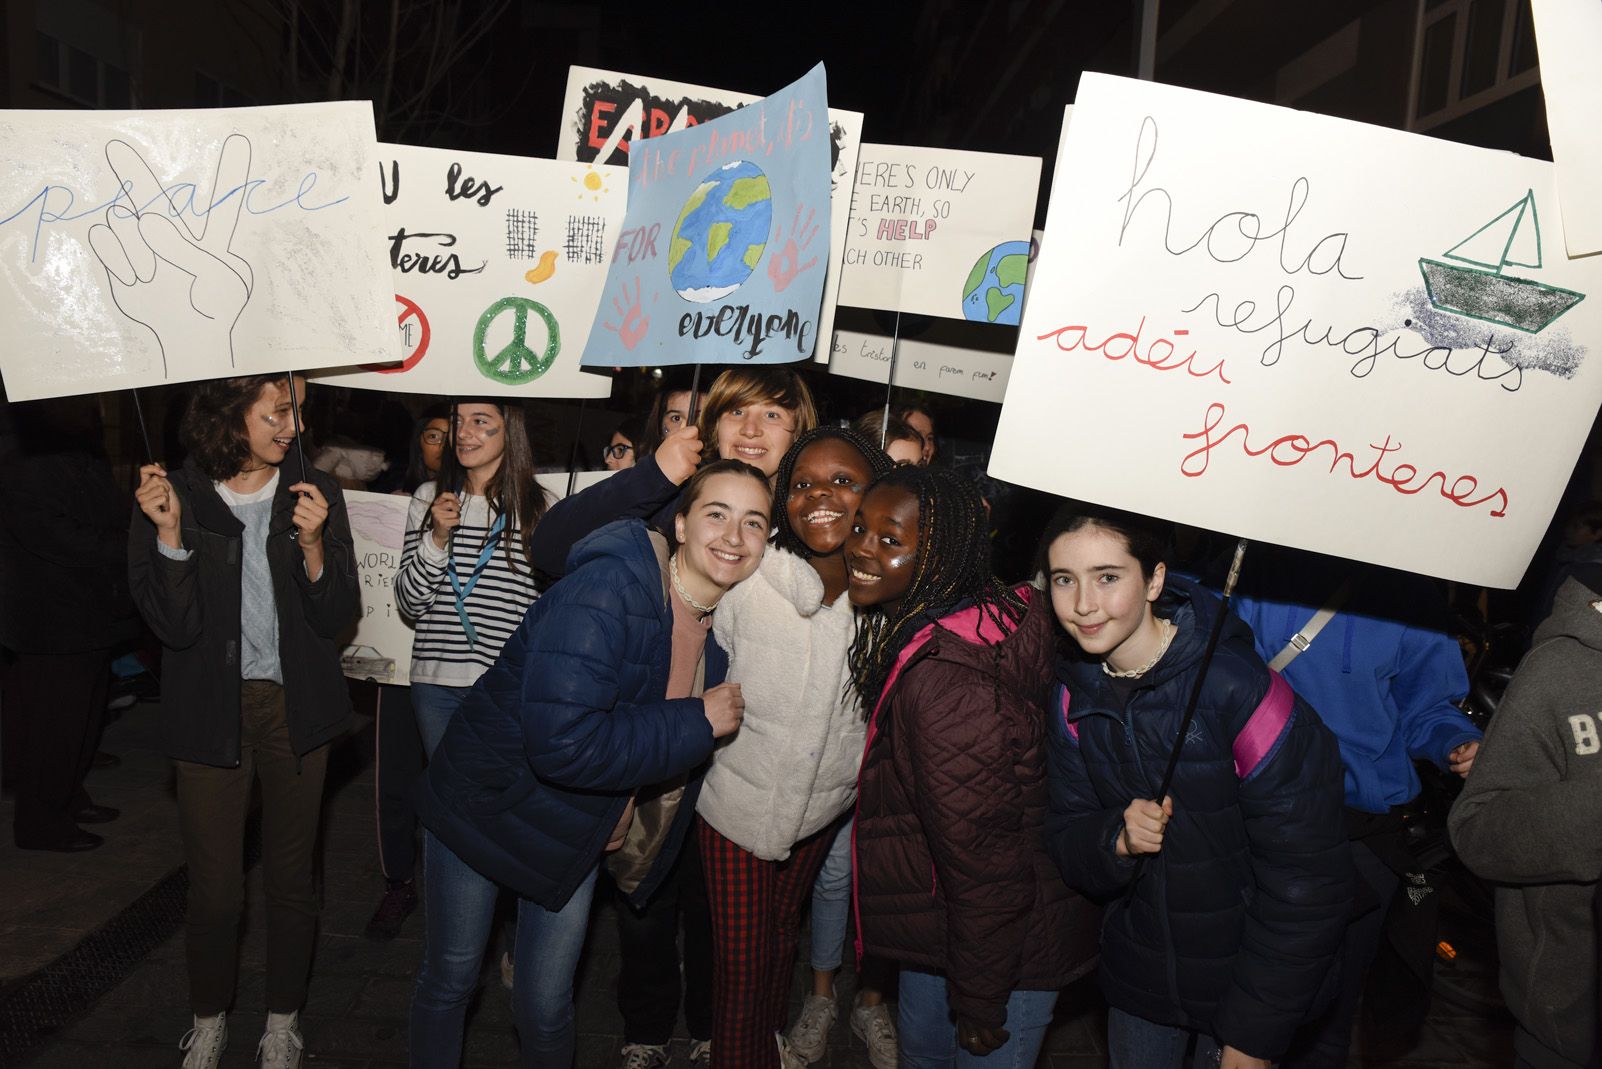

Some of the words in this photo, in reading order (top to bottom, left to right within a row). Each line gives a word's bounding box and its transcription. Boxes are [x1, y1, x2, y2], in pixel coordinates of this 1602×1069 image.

[445, 162, 504, 207] les
[855, 161, 917, 189] ERE'S
[925, 165, 976, 193] ONLY
[1117, 115, 1365, 281] hola
[0, 172, 350, 263] peace
[870, 193, 926, 218] EARTH,
[932, 199, 951, 219] SO
[876, 217, 937, 241] HELP
[612, 222, 661, 265] FOR
[844, 248, 867, 265] CH
[873, 250, 923, 270] OTHER
[678, 304, 812, 361] everyone
[1036, 315, 1232, 385] adéu
[1181, 284, 1523, 393] refugiats
[1180, 402, 1509, 518] fronteres
